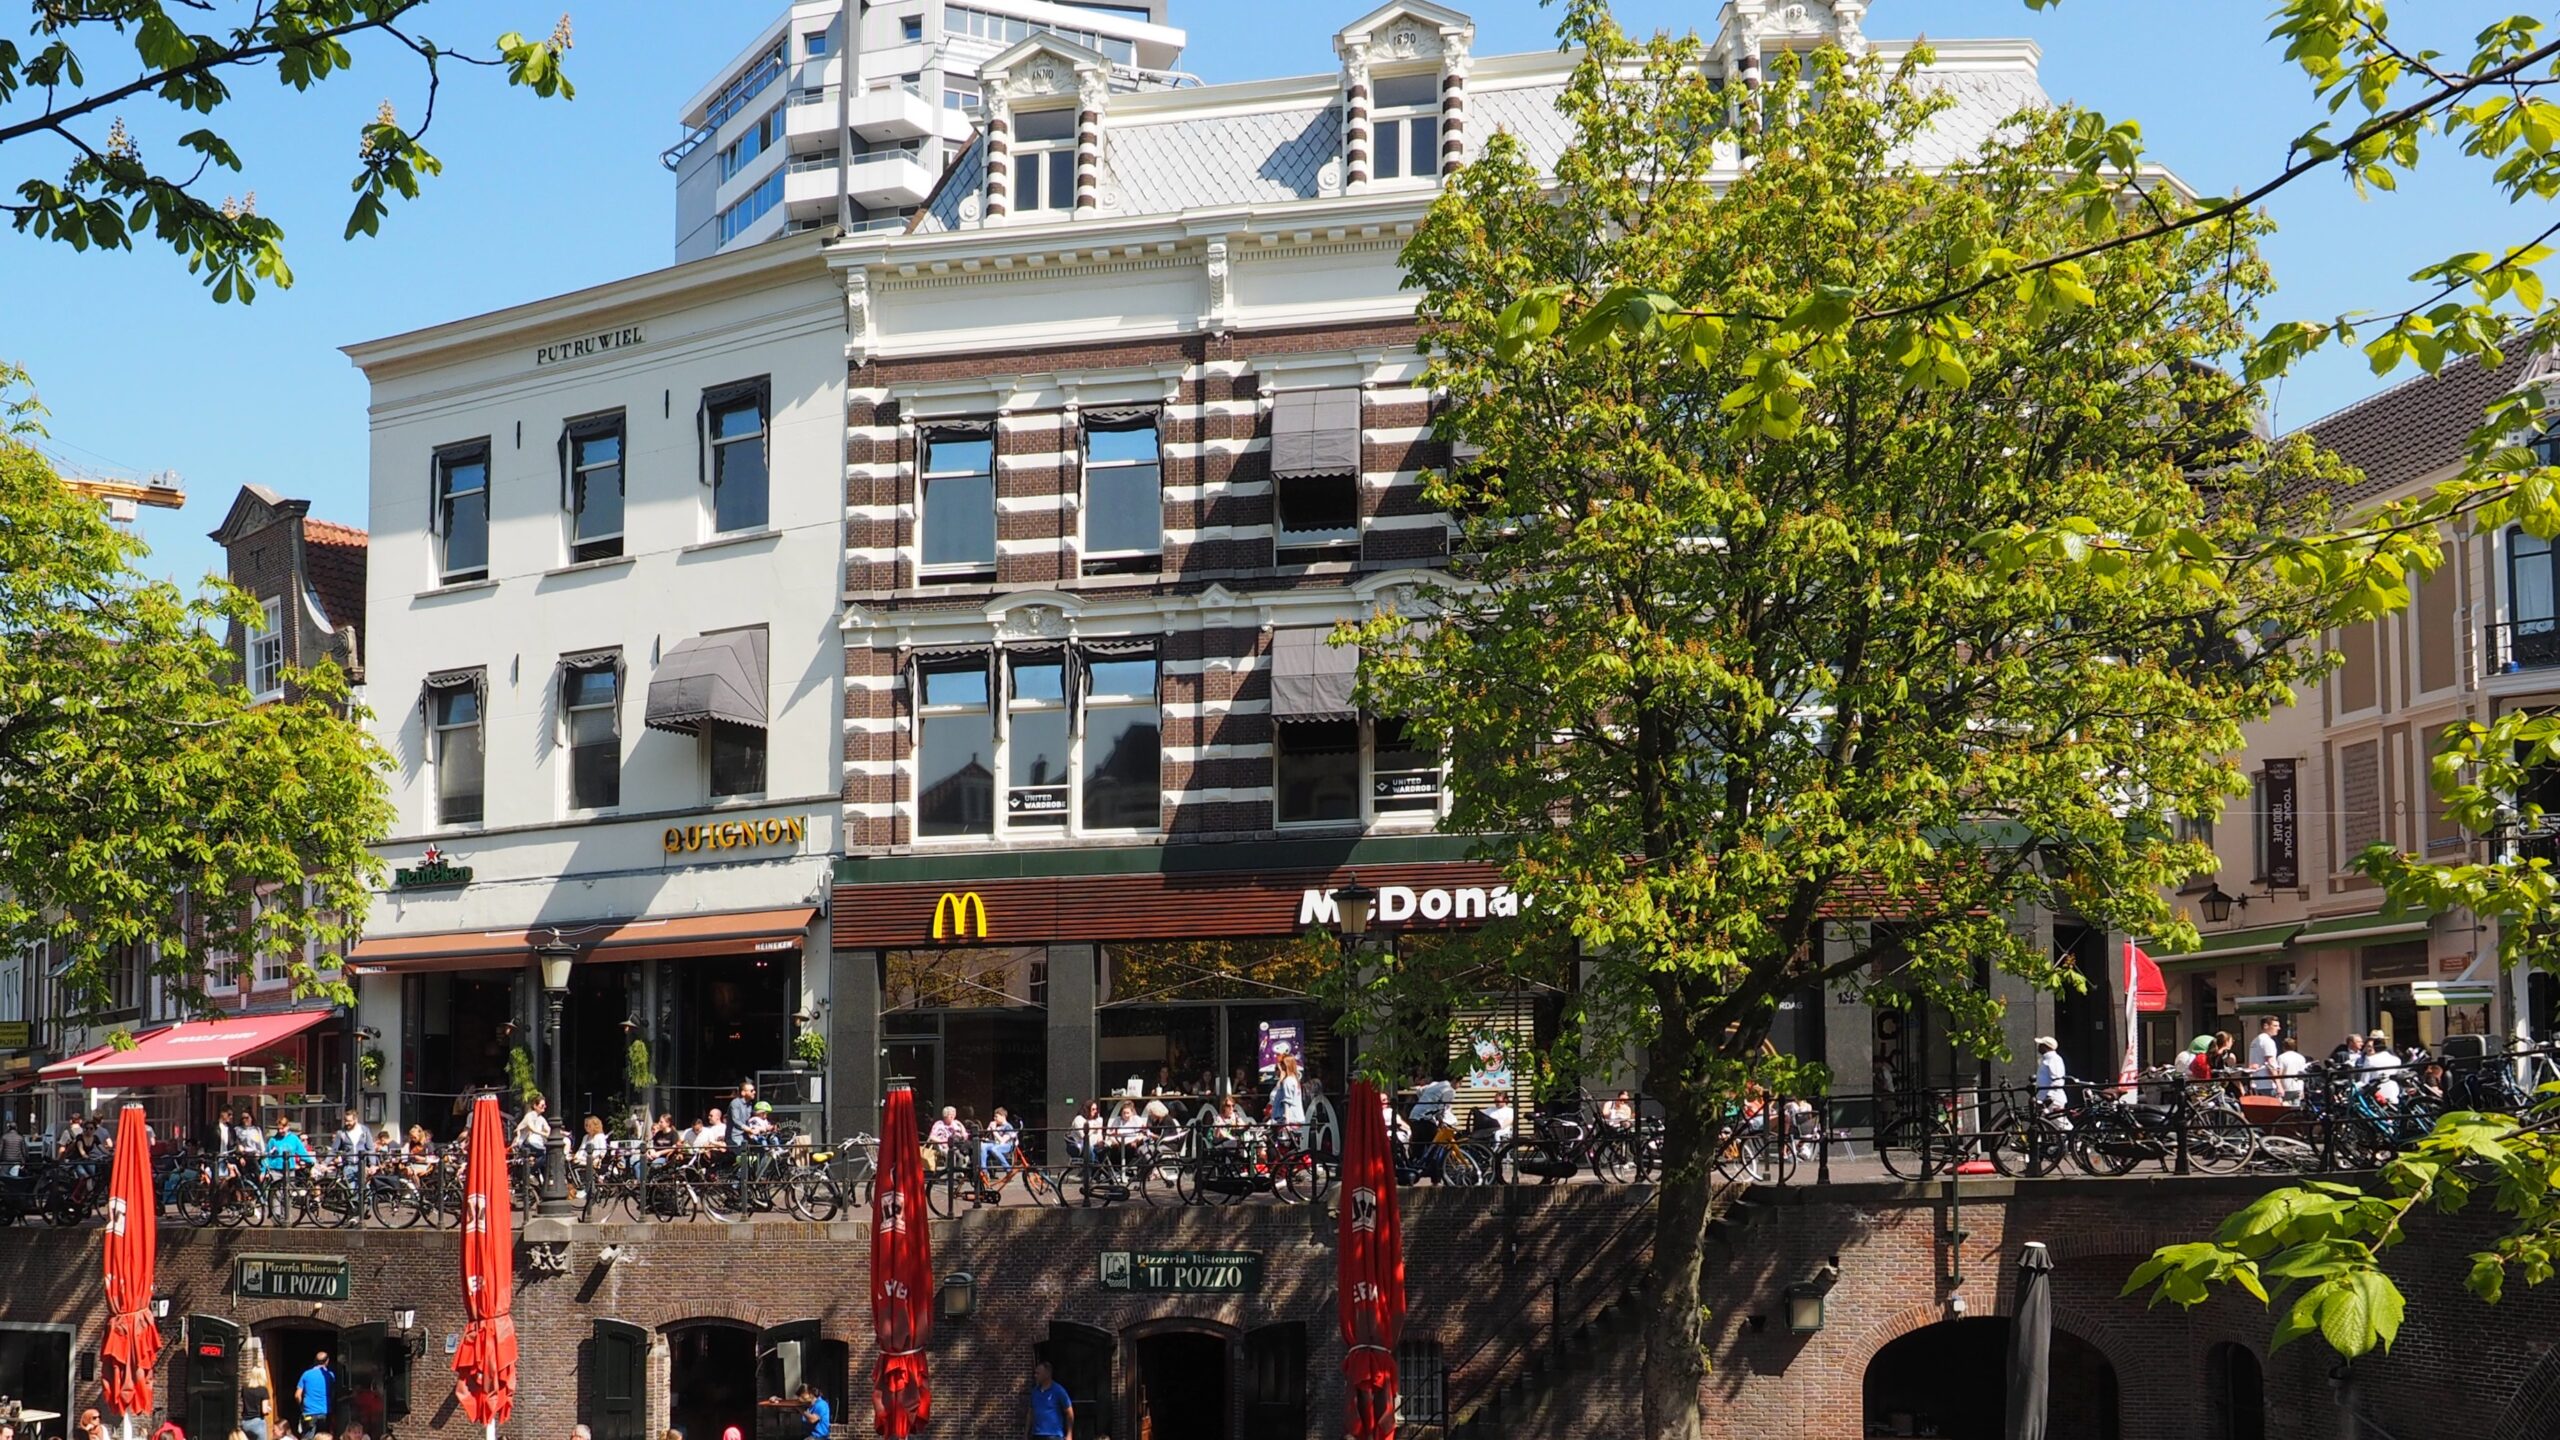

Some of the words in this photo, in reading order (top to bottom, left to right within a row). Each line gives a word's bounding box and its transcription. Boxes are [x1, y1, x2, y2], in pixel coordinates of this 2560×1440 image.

[1393, 32, 1416, 46] 1890
[1032, 69, 1054, 80] ANNO
[1392, 785, 1437, 793] WARDROBE
[1024, 801, 1066, 809] WARDROBE
[2283, 787, 2292, 822] TOQUE
[2272, 803, 2282, 823] FOOD
[662, 815, 805, 853] QUIGNON
[2284, 825, 2292, 859] TOQUE
[395, 861, 473, 886] Heineken
[755, 940, 794, 951] HEINEKEN
[1136, 1254, 1187, 1265] Pizzeria
[1192, 1254, 1256, 1265] Ristorante
[265, 1261, 300, 1273] Pizzeria
[301, 1262, 346, 1275] Ristorante
[1149, 1267, 1169, 1288] IL
[1173, 1265, 1243, 1288] POZZO
[272, 1274, 287, 1294] IL
[290, 1275, 338, 1296] POZZO
[200, 1345, 221, 1356] OPEN
